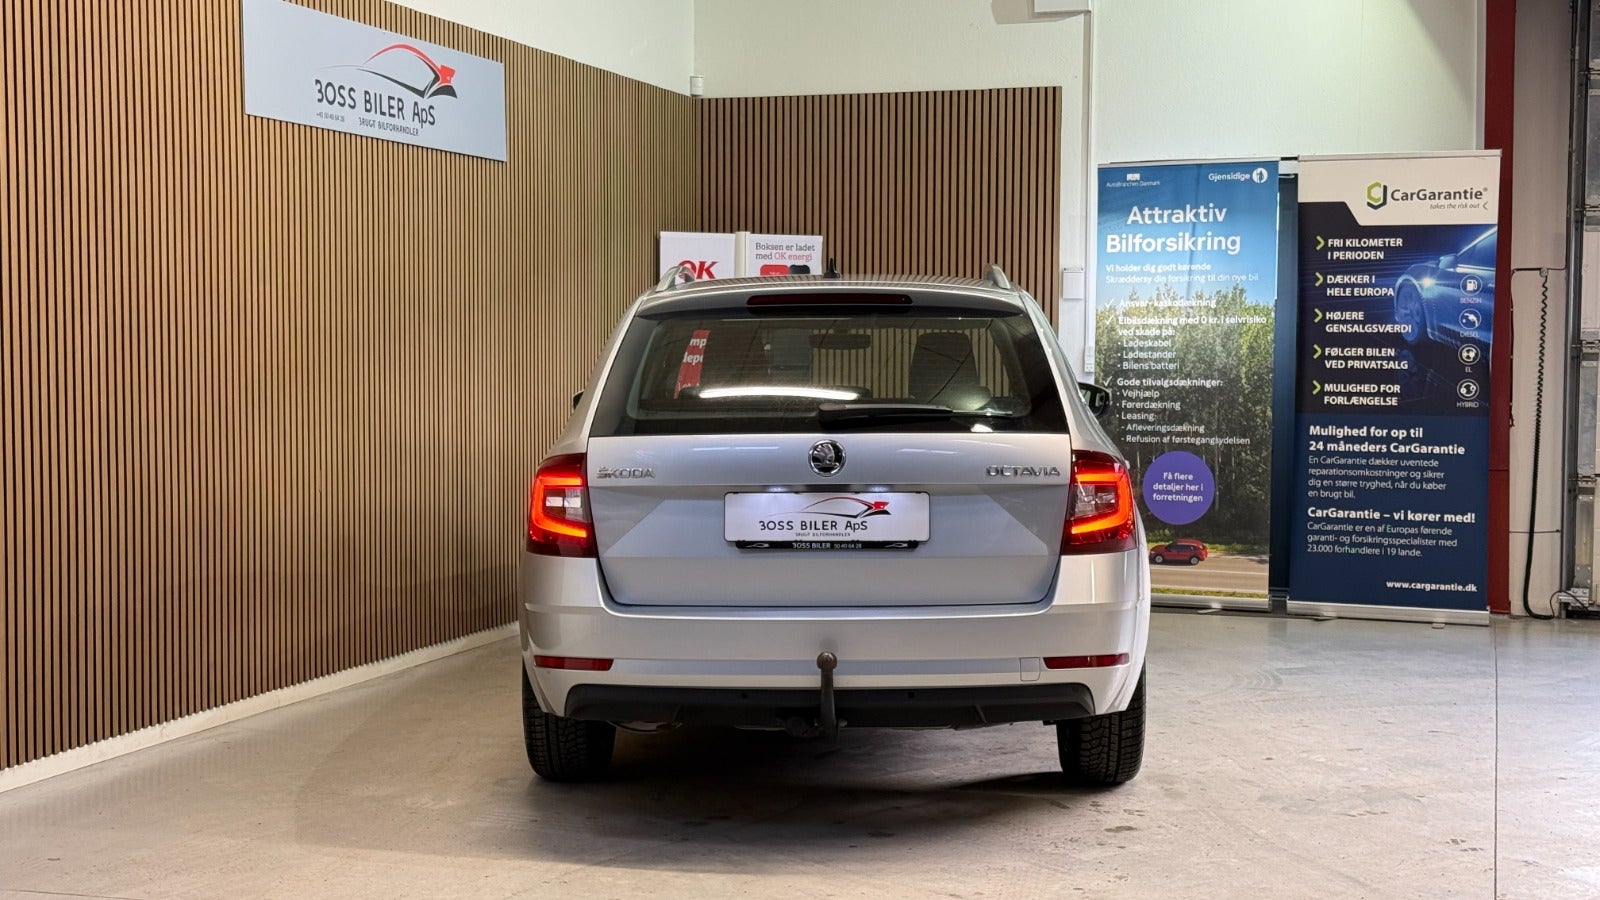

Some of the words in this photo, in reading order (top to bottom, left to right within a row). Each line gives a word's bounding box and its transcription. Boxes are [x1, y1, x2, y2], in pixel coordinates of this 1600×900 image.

[364, 90, 405, 120] BILER
[412, 101, 436, 128] ApS
[378, 121, 419, 136] BILFORHANDLER
[1208, 172, 1250, 181] Gjensidige
[1126, 203, 1227, 225] Attraktiv
[755, 242, 783, 251] Boksen
[796, 243, 815, 251] ladet
[1106, 231, 1241, 255] Bilforsikring
[1327, 239, 1343, 247] FRI
[1346, 238, 1403, 247] KILOMETER
[788, 253, 812, 262] energi
[1333, 251, 1384, 260] PERIODEN
[1106, 264, 1114, 272] Vi
[1116, 264, 1141, 272] holder
[1143, 264, 1156, 273] dig
[1157, 264, 1176, 273] godt
[1178, 263, 1212, 271] kørende
[1154, 275, 1166, 283] din
[1168, 274, 1206, 283] forsikring
[1232, 274, 1247, 282] nye
[1248, 273, 1258, 281] bil
[1327, 275, 1370, 284] DÆKKER
[1327, 288, 1352, 296] HELE
[1354, 288, 1395, 296] EUROPA
[1119, 315, 1178, 326] Elbilsdækning
[1179, 315, 1199, 324] med
[1208, 316, 1219, 324] kr.
[1225, 315, 1267, 323] selvrisiko
[1326, 311, 1364, 320] HØJERE
[1162, 327, 1175, 337] på:
[1325, 324, 1411, 333] GENSALGSVÆRDI
[1123, 339, 1171, 347] Ladeskabel
[1325, 348, 1364, 356] FØLGER
[1366, 348, 1395, 357] BILEN
[1123, 362, 1149, 370] Bilens
[1150, 362, 1179, 370] batteri
[1325, 360, 1345, 369] VED
[1348, 361, 1408, 369] PRIVATSALG
[1117, 378, 1140, 386] Gode
[1142, 378, 1223, 387] tilvalgsdækninger:
[1122, 389, 1159, 398] Vejhjælp
[1324, 384, 1377, 393] MULIGHED
[1380, 385, 1400, 393] FOR
[1122, 401, 1181, 409] Førerdækning
[1324, 396, 1398, 406] FORLÆNGELSE
[1126, 424, 1205, 433] Afleveringsdækning
[1309, 426, 1367, 438] Mulighed
[1370, 427, 1388, 437] for
[1390, 428, 1407, 439] op
[1410, 428, 1423, 438] til
[1309, 442, 1324, 451] 24
[1327, 441, 1387, 452] måneders
[1390, 443, 1465, 455] CarGarantie
[1320, 456, 1367, 465] CarGarantie
[1368, 457, 1398, 465] dækker
[1401, 459, 1439, 467] uventede
[597, 466, 656, 479] ŠKODA
[986, 465, 1061, 477] OCTAVIA
[1163, 472, 1172, 480] Få
[1174, 472, 1193, 480] flere
[1308, 468, 1408, 479] reparationsomkostninger
[1423, 470, 1444, 478] sikrer
[1153, 483, 1183, 492] detaljer
[1186, 483, 1198, 491] her
[1308, 478, 1321, 488] dig
[1360, 480, 1393, 490] tryghed,
[1410, 481, 1420, 489] du
[1423, 482, 1446, 490] køber
[1153, 493, 1202, 502] forretningen
[1320, 489, 1342, 499] brugt
[1344, 490, 1355, 498] bil.
[1308, 507, 1380, 520] CarGarantie
[1393, 511, 1404, 520] vi
[1408, 511, 1441, 522] kører
[1444, 512, 1475, 523] med!
[801, 520, 838, 530] BILER
[845, 520, 867, 533] ApS
[1307, 522, 1353, 531] CarGarantie
[1377, 524, 1385, 532] af
[1386, 525, 1418, 535] Europas
[1421, 526, 1452, 535] førende
[1307, 534, 1337, 542] garanti-
[1339, 536, 1350, 544] og
[1352, 535, 1436, 546] forsikringsspecialister
[1439, 539, 1457, 547] med
[1307, 544, 1333, 552] 23.000
[1334, 545, 1380, 555] forhandlere
[1398, 548, 1422, 556] lande.
[1386, 581, 1477, 592] www.cargarantie.dk
